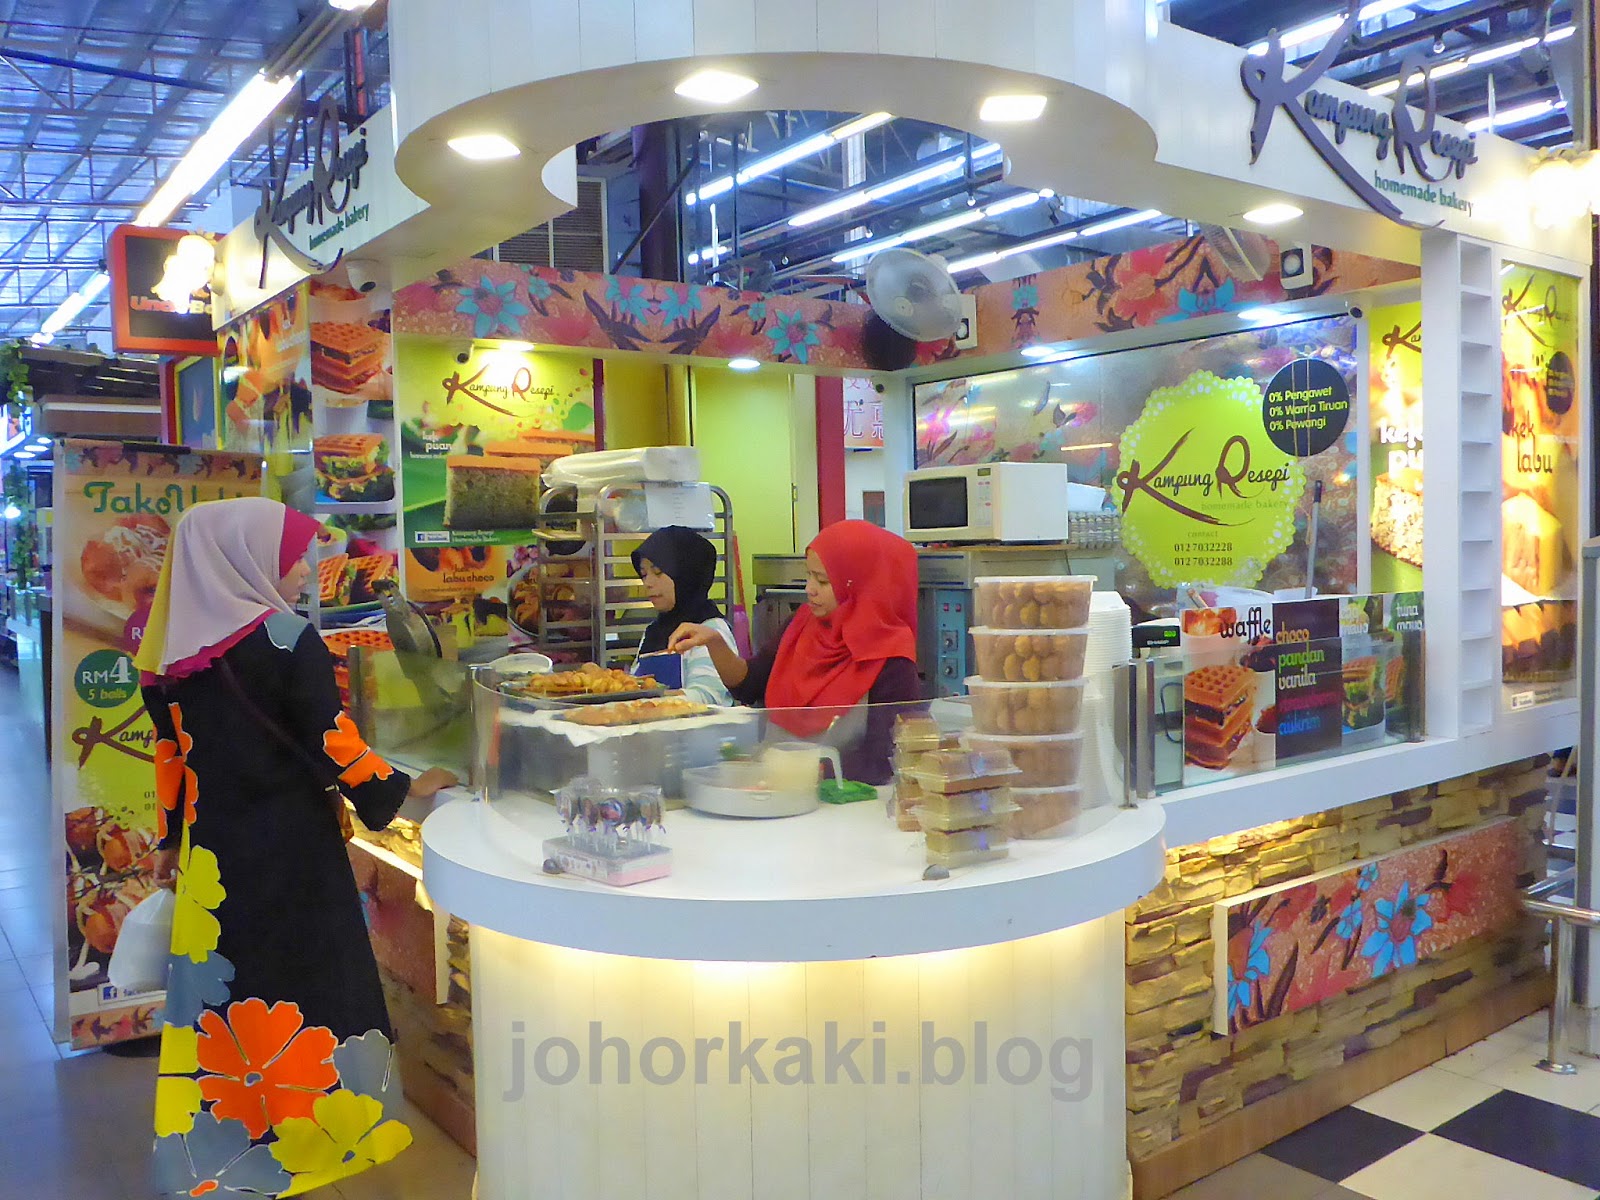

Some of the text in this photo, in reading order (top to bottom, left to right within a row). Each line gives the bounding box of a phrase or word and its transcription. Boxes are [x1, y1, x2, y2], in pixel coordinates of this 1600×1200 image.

[1240, 0, 1478, 229] Kampung Resepi
[1374, 170, 1474, 217] homemade bakery
[1268, 385, 1333, 403] 0% Pengawet
[1269, 406, 1284, 417] 0%
[1317, 400, 1348, 412] Tiruan
[1269, 416, 1327, 431] 0% Pewangi
[1116, 426, 1290, 527] Kampung Resepi
[1220, 606, 1271, 644] waffle
[1275, 621, 1310, 645] choco
[82, 656, 132, 684] RM4
[1278, 641, 1325, 674] pandan
[87, 686, 127, 699] 5 balls
[72, 704, 155, 770] Kamp
